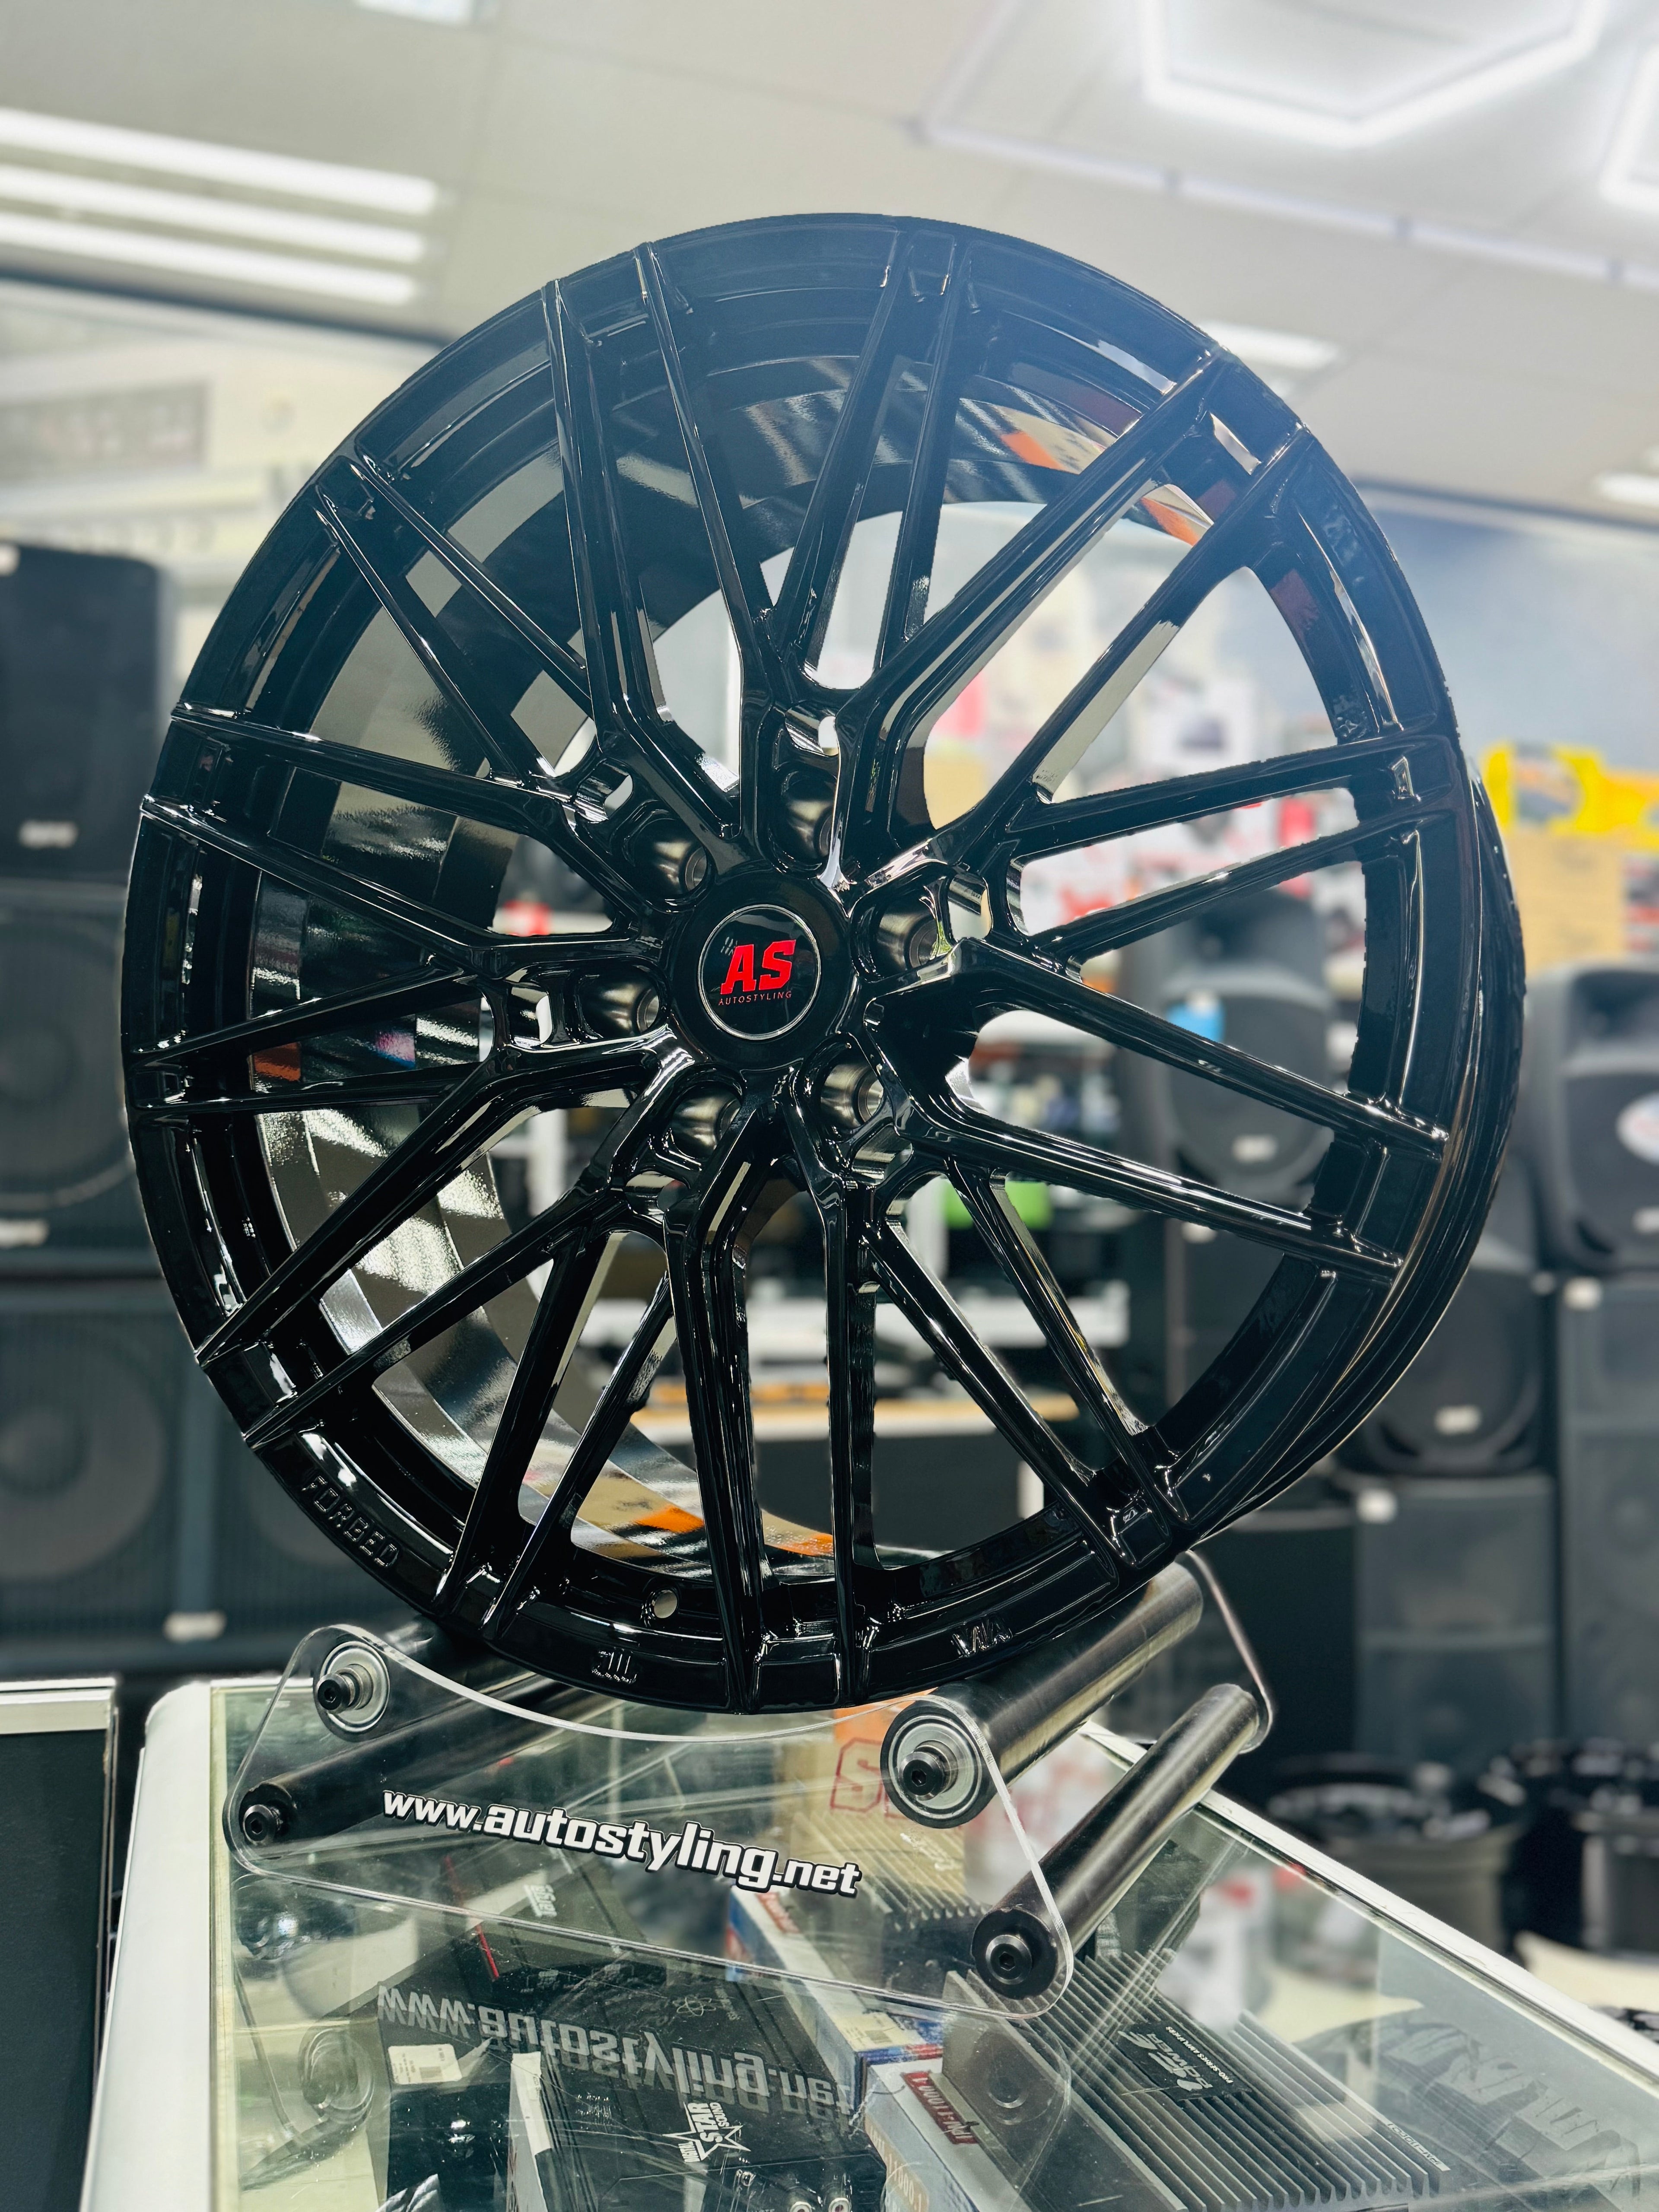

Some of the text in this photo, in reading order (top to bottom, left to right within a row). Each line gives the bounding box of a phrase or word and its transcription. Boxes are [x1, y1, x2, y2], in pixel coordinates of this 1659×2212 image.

[720, 939, 797, 995] AS
[718, 991, 792, 1006] AUTOSTYLING
[301, 1475, 400, 1568] FORGED
[382, 1790, 861, 1897] www.autostyling.net
[1146, 2033, 1213, 2088] POWER
[687, 2102, 723, 2143] STAR
[709, 2102, 730, 2127] SOUND
[678, 2141, 700, 2162] DIGITAL
